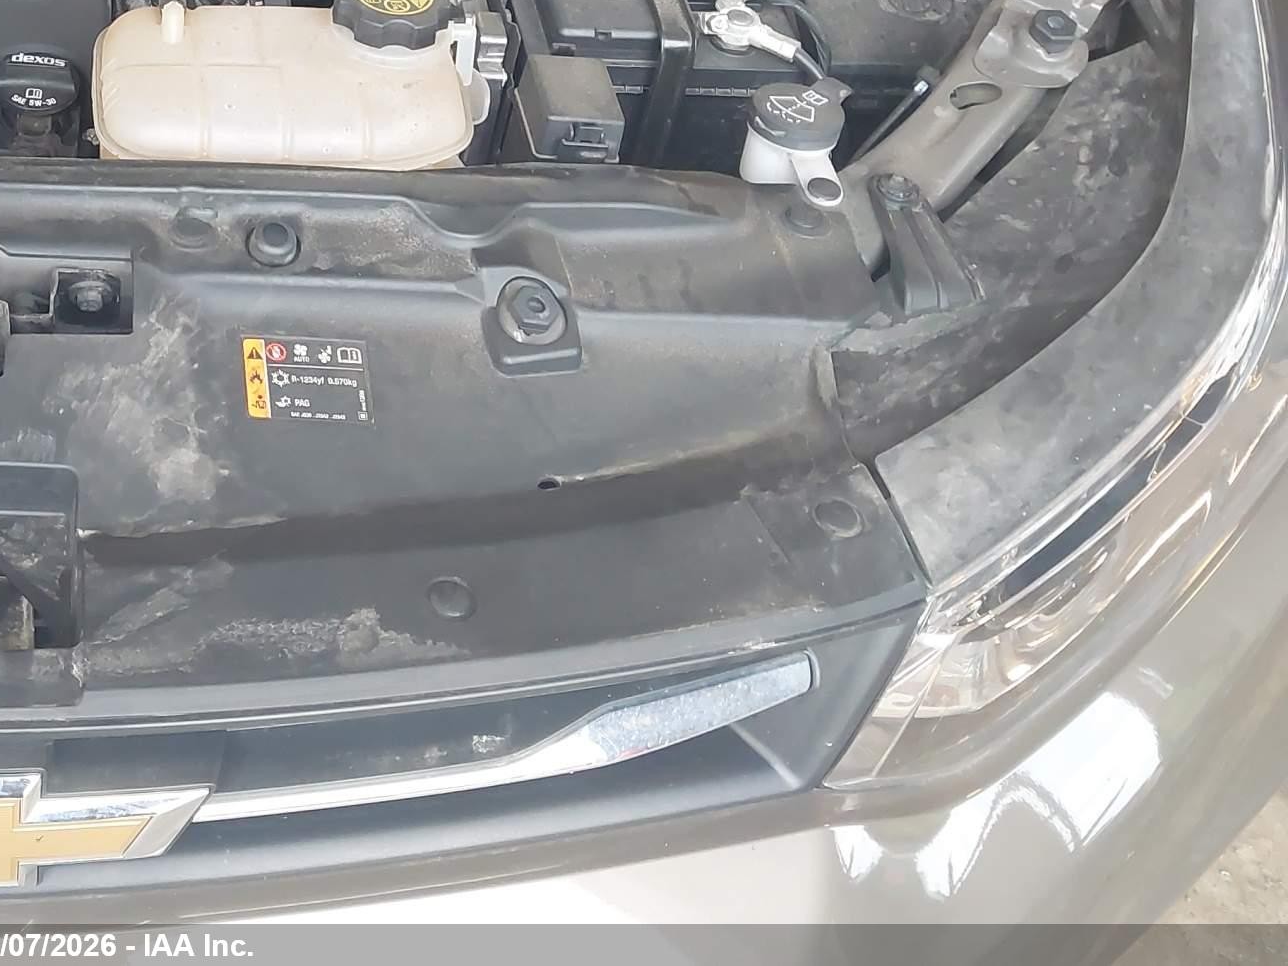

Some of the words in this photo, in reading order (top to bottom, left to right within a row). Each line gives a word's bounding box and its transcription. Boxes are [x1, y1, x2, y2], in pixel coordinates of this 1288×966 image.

[11, 52, 66, 68] dexos
[11, 94, 27, 106] SAE
[28, 96, 57, 107] 5W-30
